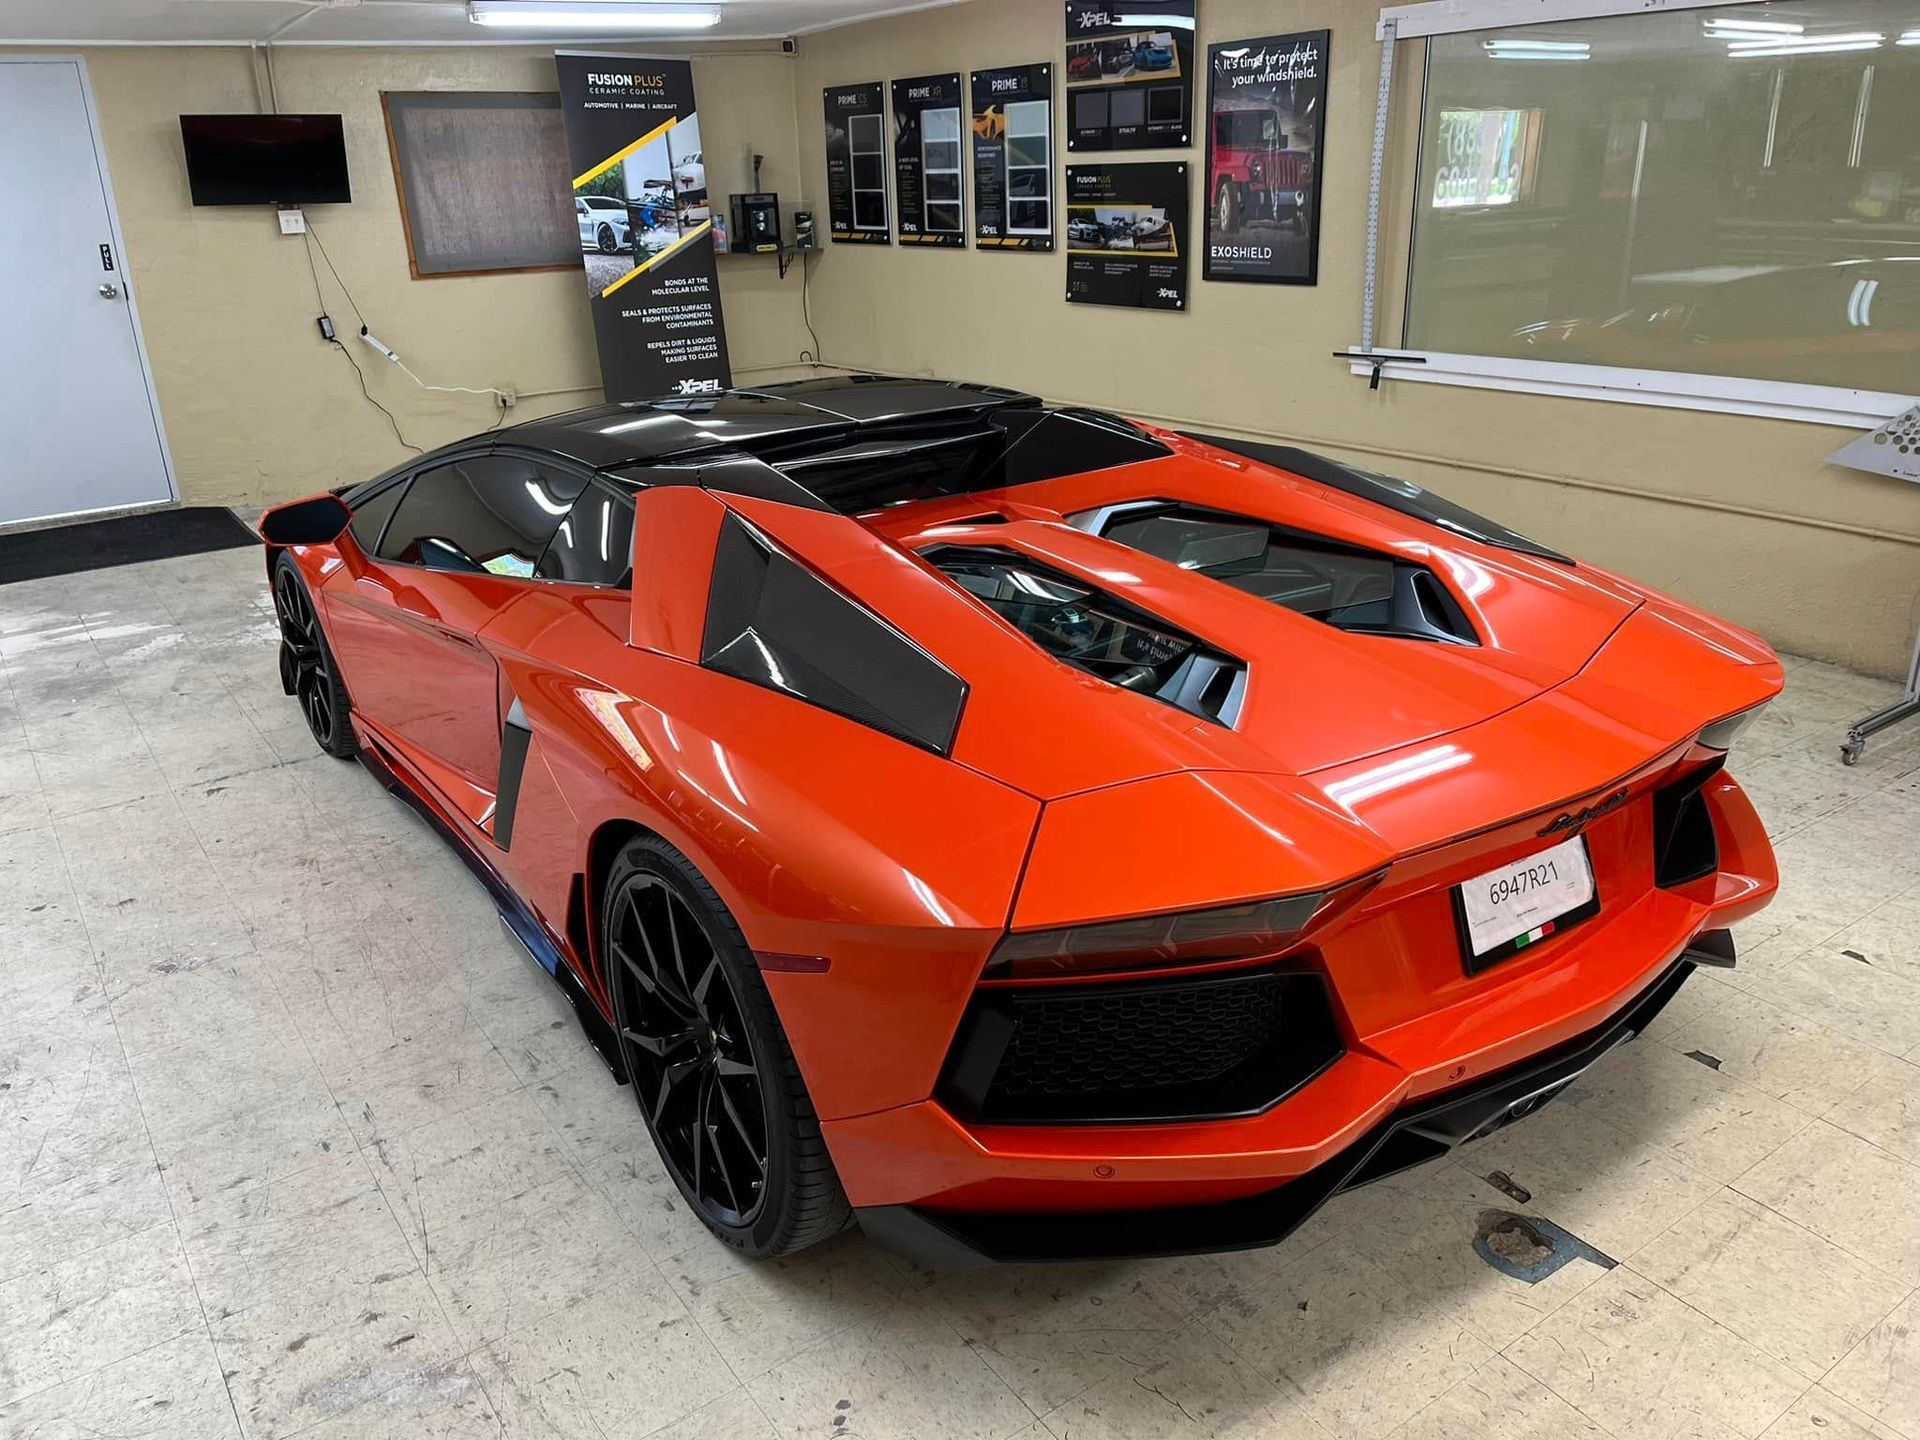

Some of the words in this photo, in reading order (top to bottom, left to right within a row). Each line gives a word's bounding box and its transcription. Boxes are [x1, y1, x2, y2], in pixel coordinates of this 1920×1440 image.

[1080, 11, 1111, 28] XPEL
[1223, 58, 1238, 70] It's
[1240, 55, 1263, 67] time
[1265, 55, 1276, 65] to
[1279, 48, 1318, 67] protect
[587, 73, 633, 86] FUSION
[1232, 74, 1255, 89] your
[1257, 65, 1317, 83] windshield.
[589, 87, 626, 95] CERAMIC
[629, 88, 665, 96] COATING
[991, 78, 1018, 92] PRIME
[908, 86, 930, 99] PRIME
[625, 102, 646, 110] MARINE
[838, 94, 857, 106] PRIME
[102, 246, 111, 269] PULL
[1211, 246, 1272, 259] EXOSHIELD
[651, 286, 690, 295] MOLECULAR
[691, 285, 710, 293] LEVEL
[1159, 287, 1178, 298] XPEL
[621, 309, 642, 317] SEALS
[648, 305, 680, 315] PROTECTS
[681, 303, 712, 313] SURFACES
[661, 311, 713, 322] ENVIRONMENTAL
[665, 319, 714, 329] CONTAMINANTS
[647, 341, 671, 349] REPELS
[671, 339, 685, 347] DIRT
[691, 336, 716, 345] LIQUIDS
[661, 346, 686, 356] MAKING
[686, 344, 718, 353] SURFACES
[665, 355, 687, 364] EASIER
[697, 352, 719, 360] CLEAN
[678, 378, 723, 395] XPEL
[1489, 860, 1559, 905] 6947R21
